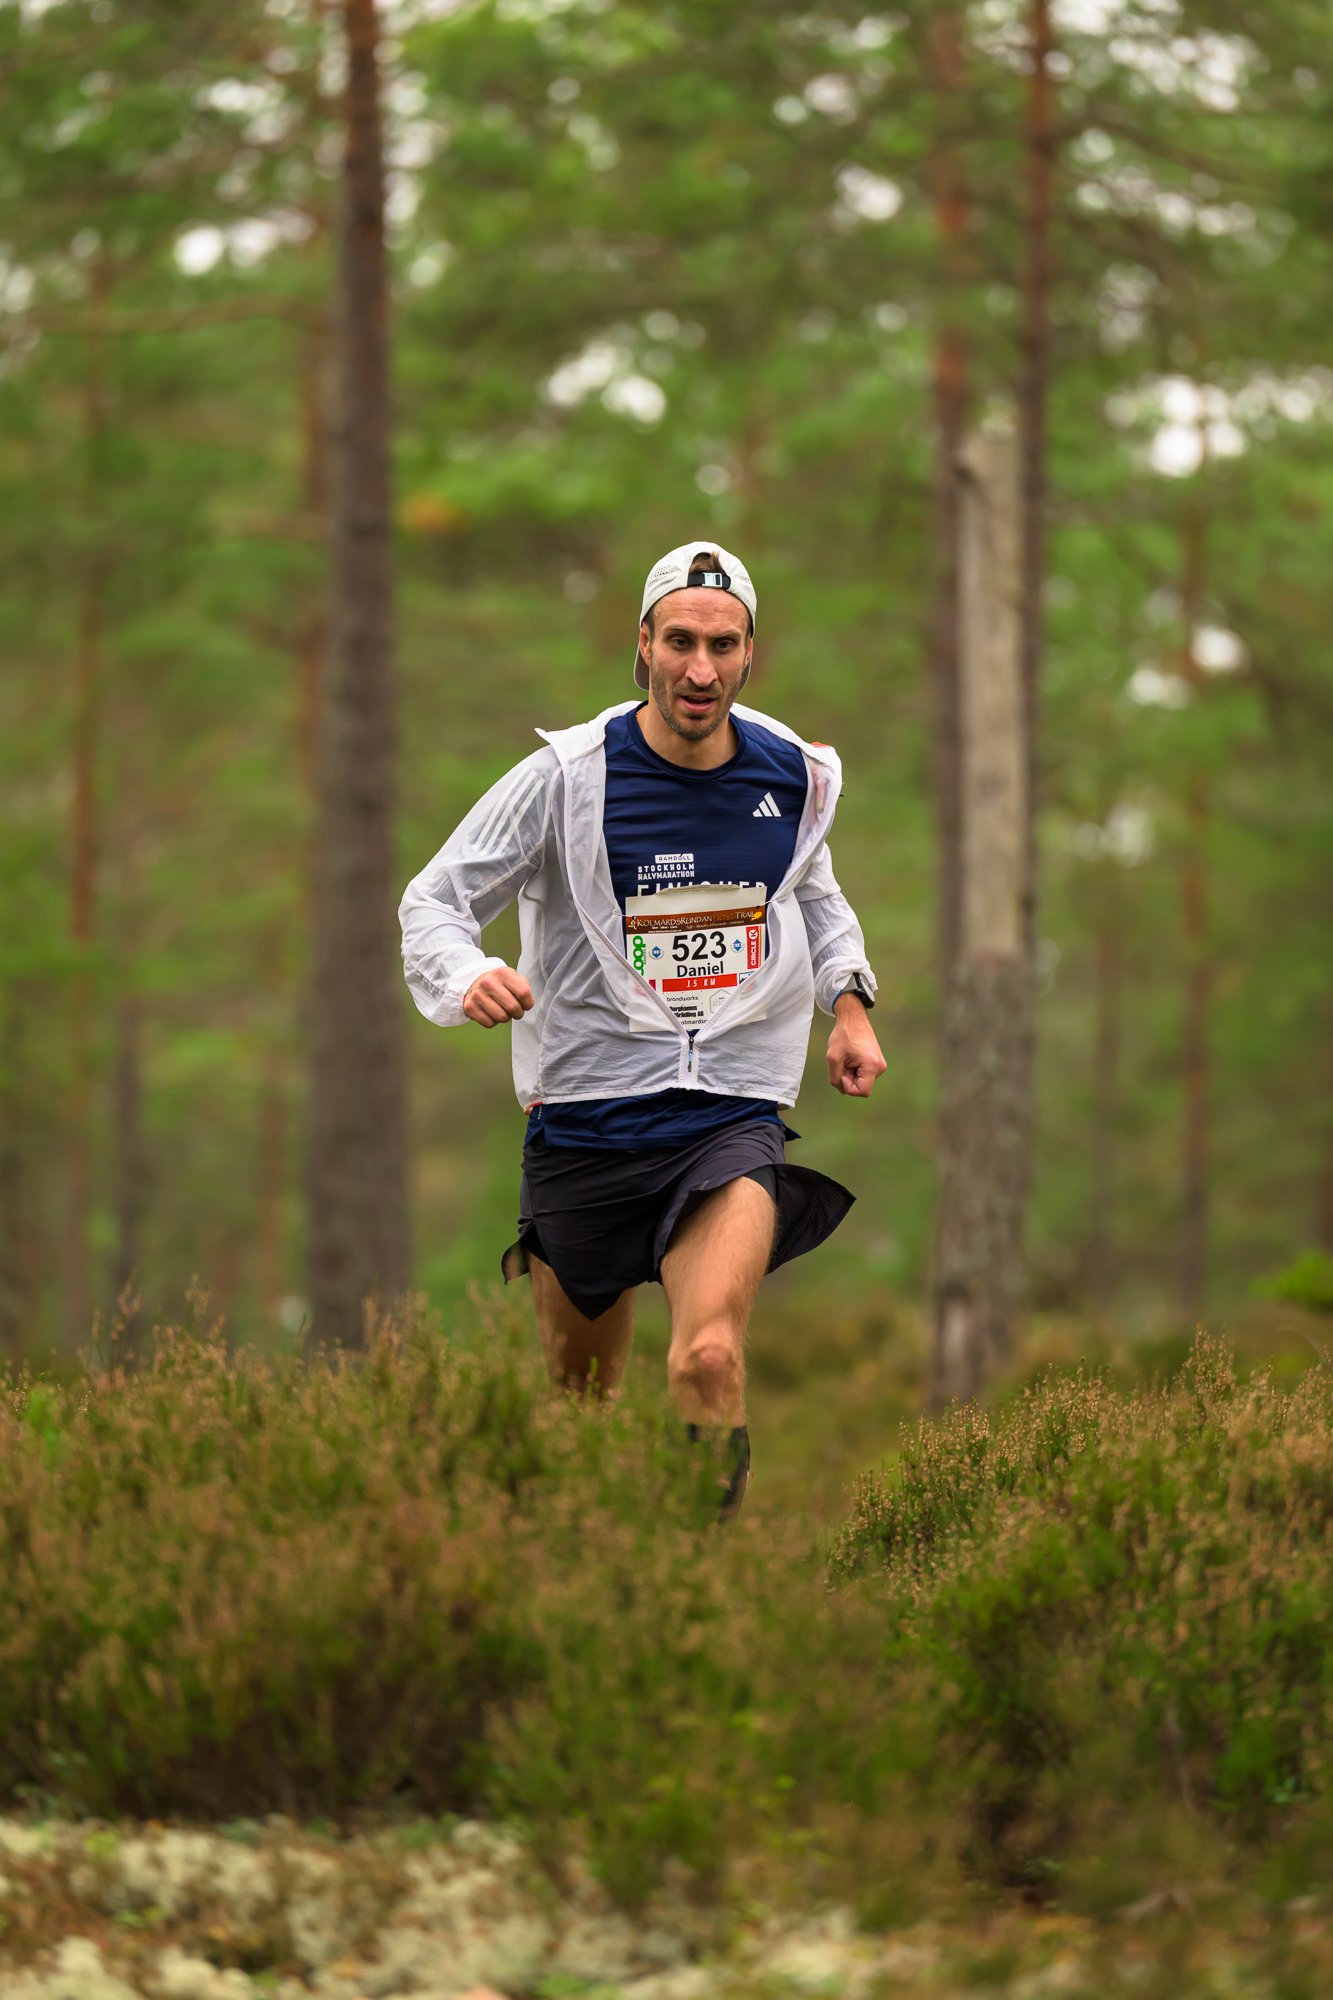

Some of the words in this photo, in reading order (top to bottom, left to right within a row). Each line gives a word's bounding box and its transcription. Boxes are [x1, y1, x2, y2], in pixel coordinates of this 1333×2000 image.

[638, 863, 695, 873] STOCKHOLM
[638, 870, 695, 881] HALVMARATHON
[671, 930, 727, 962] 523
[676, 961, 724, 978] Daniel
[686, 979, 698, 988] 15
[703, 977, 716, 987] KM
